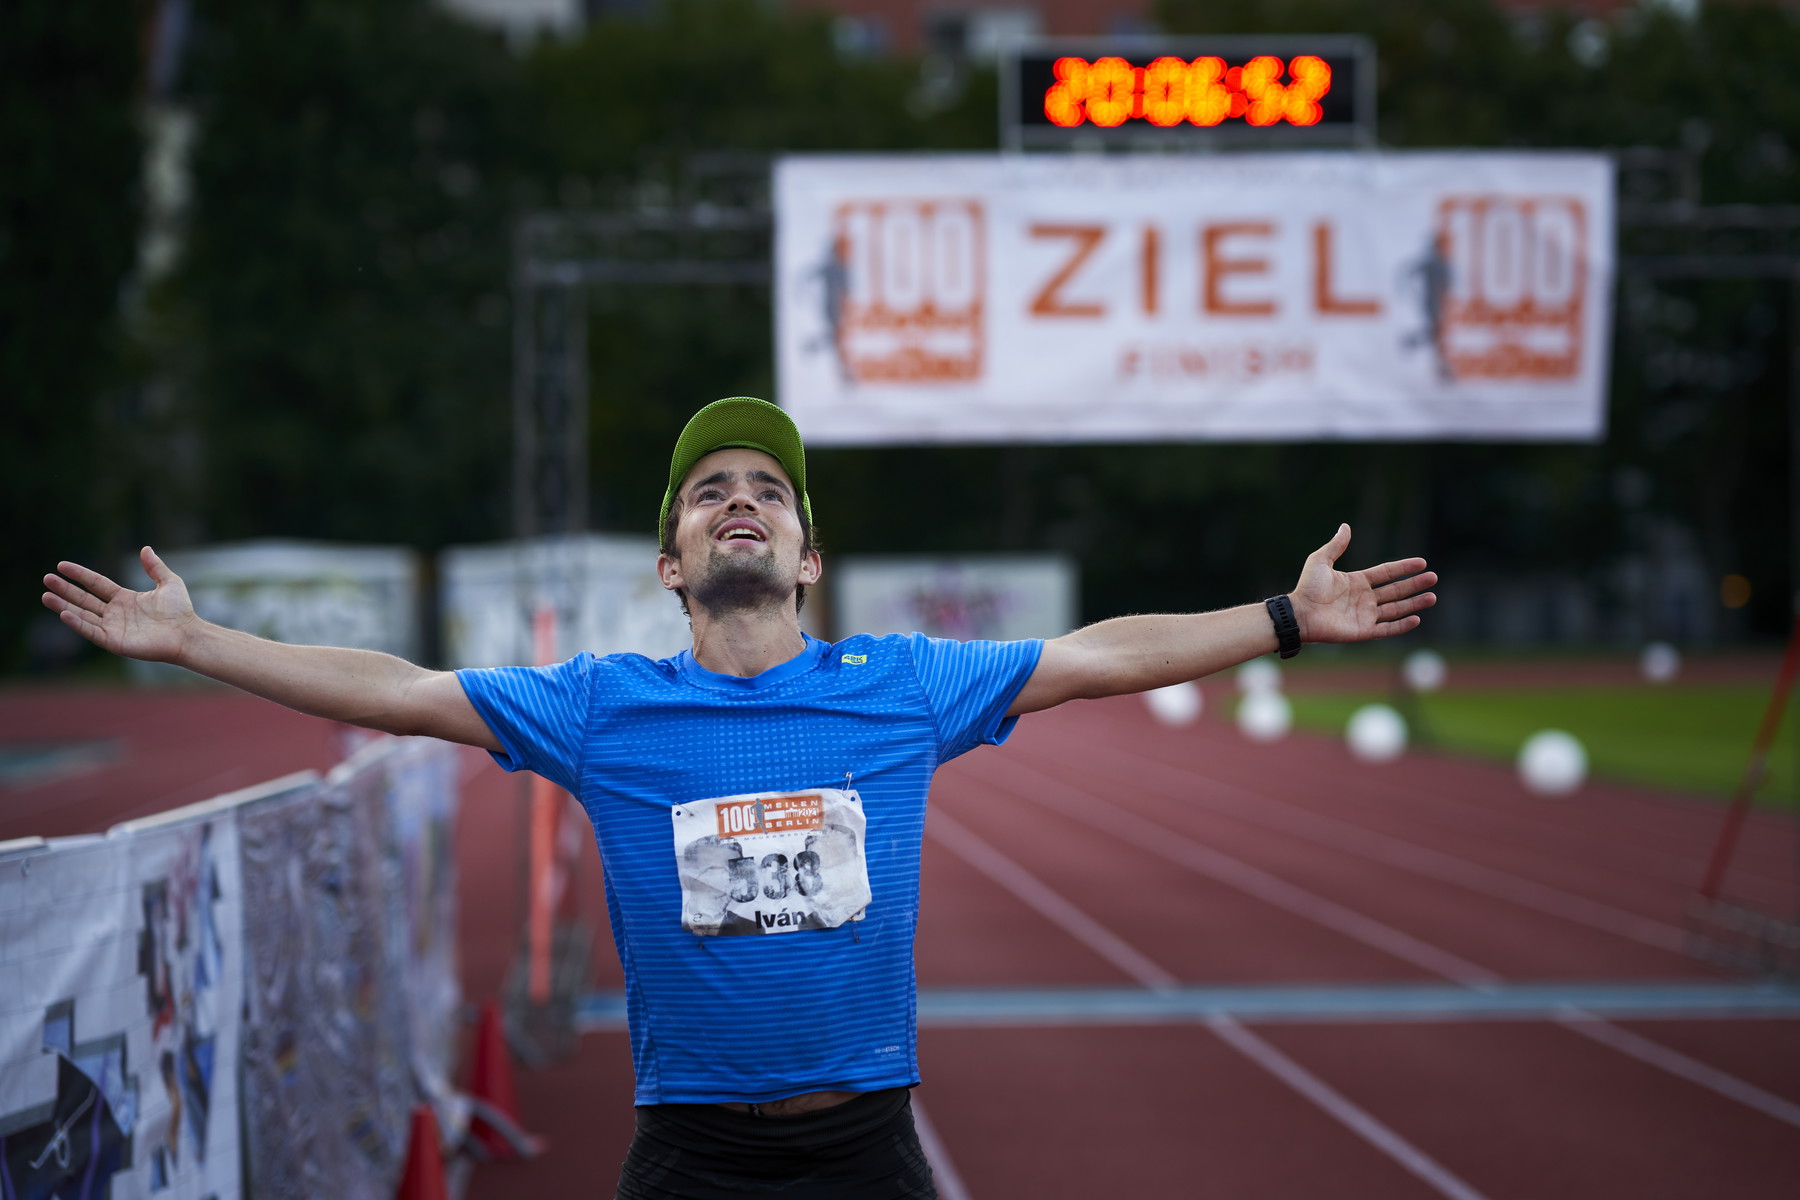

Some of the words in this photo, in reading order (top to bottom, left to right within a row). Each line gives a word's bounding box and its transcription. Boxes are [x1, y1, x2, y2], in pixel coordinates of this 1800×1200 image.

[846, 206, 978, 309] 100
[1027, 217, 1384, 319] ZIEL
[1446, 203, 1577, 308] 100
[1119, 345, 1315, 378] FINISH
[720, 805, 755, 833] 100
[764, 800, 819, 809] MEILEN
[765, 818, 820, 829] BERLIN
[728, 850, 824, 903] 538
[754, 908, 807, 929] Iván
